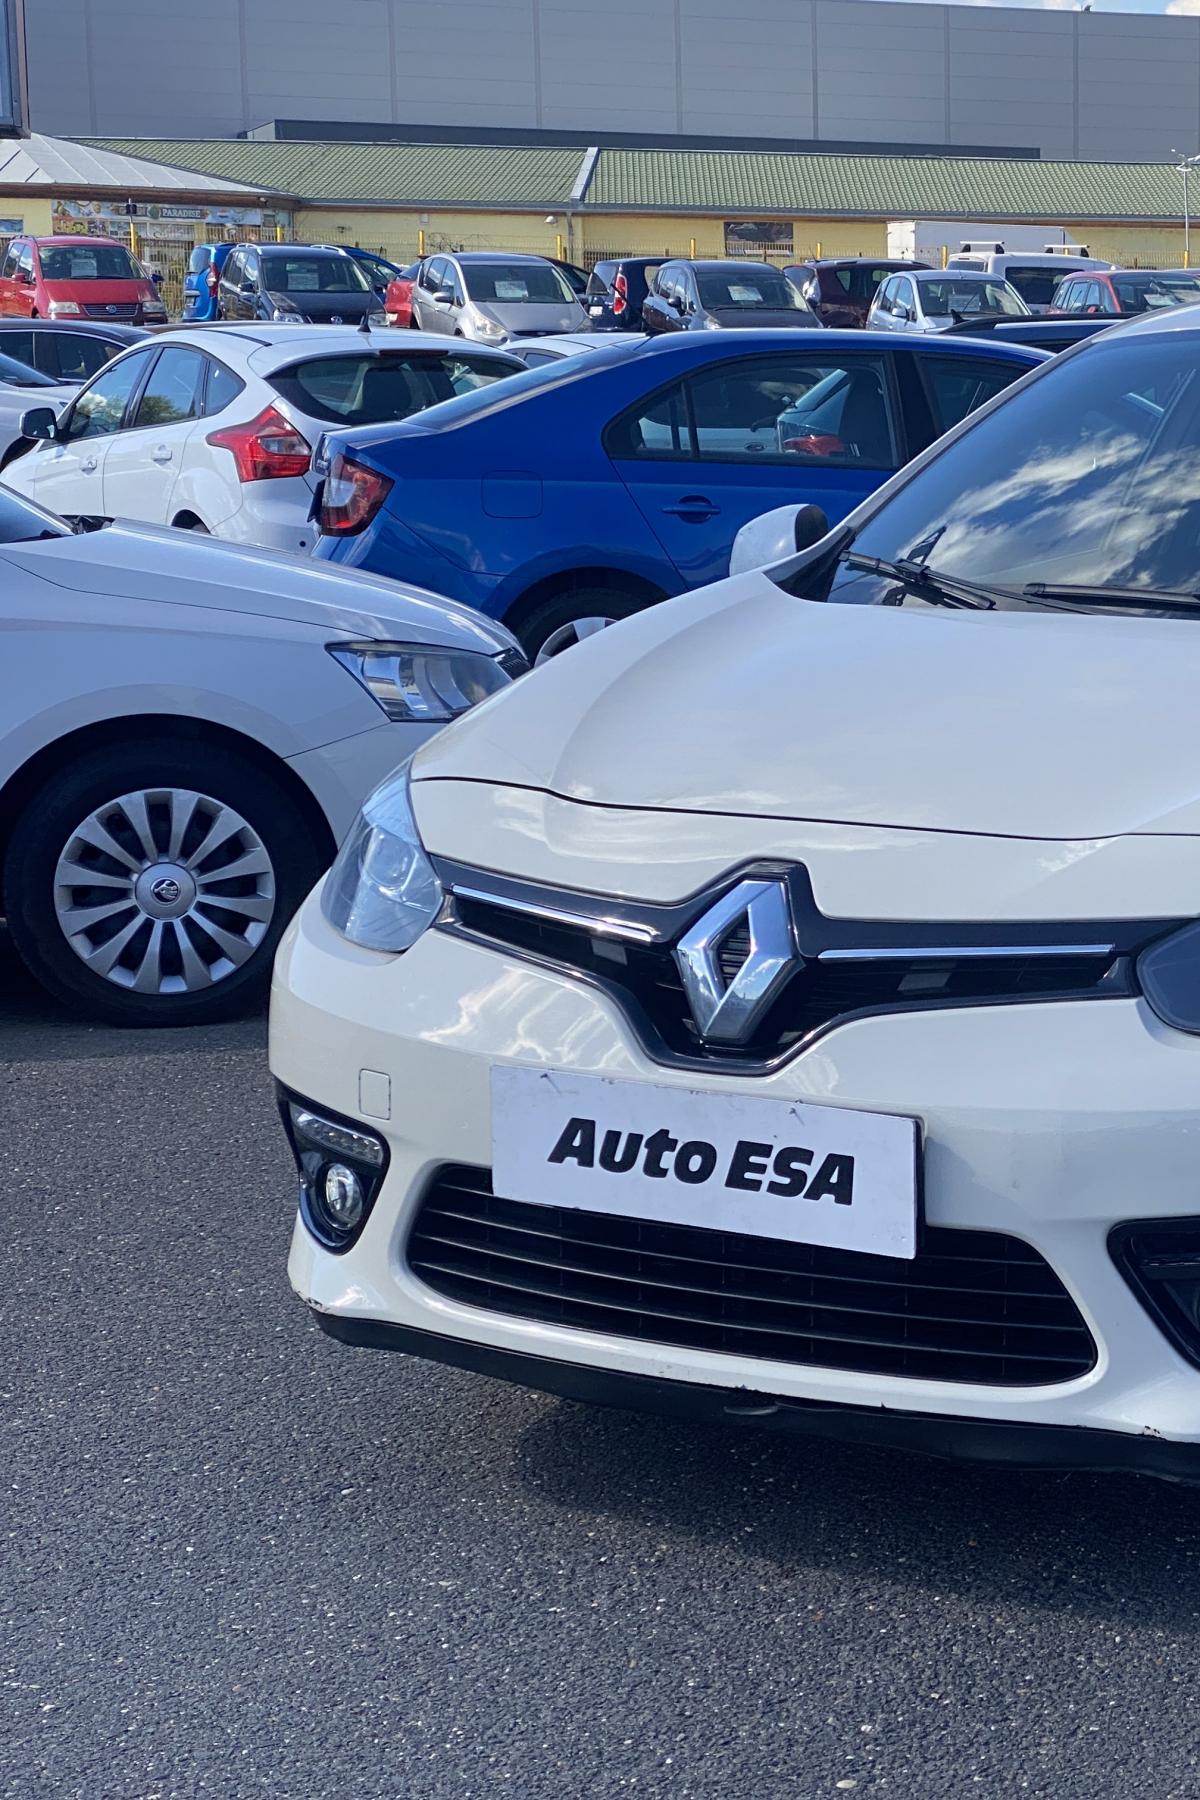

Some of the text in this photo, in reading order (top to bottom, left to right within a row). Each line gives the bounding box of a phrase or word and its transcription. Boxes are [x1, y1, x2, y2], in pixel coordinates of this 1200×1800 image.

[162, 208, 201, 217] PARADISE
[547, 1117, 855, 1206] Auto ESA
